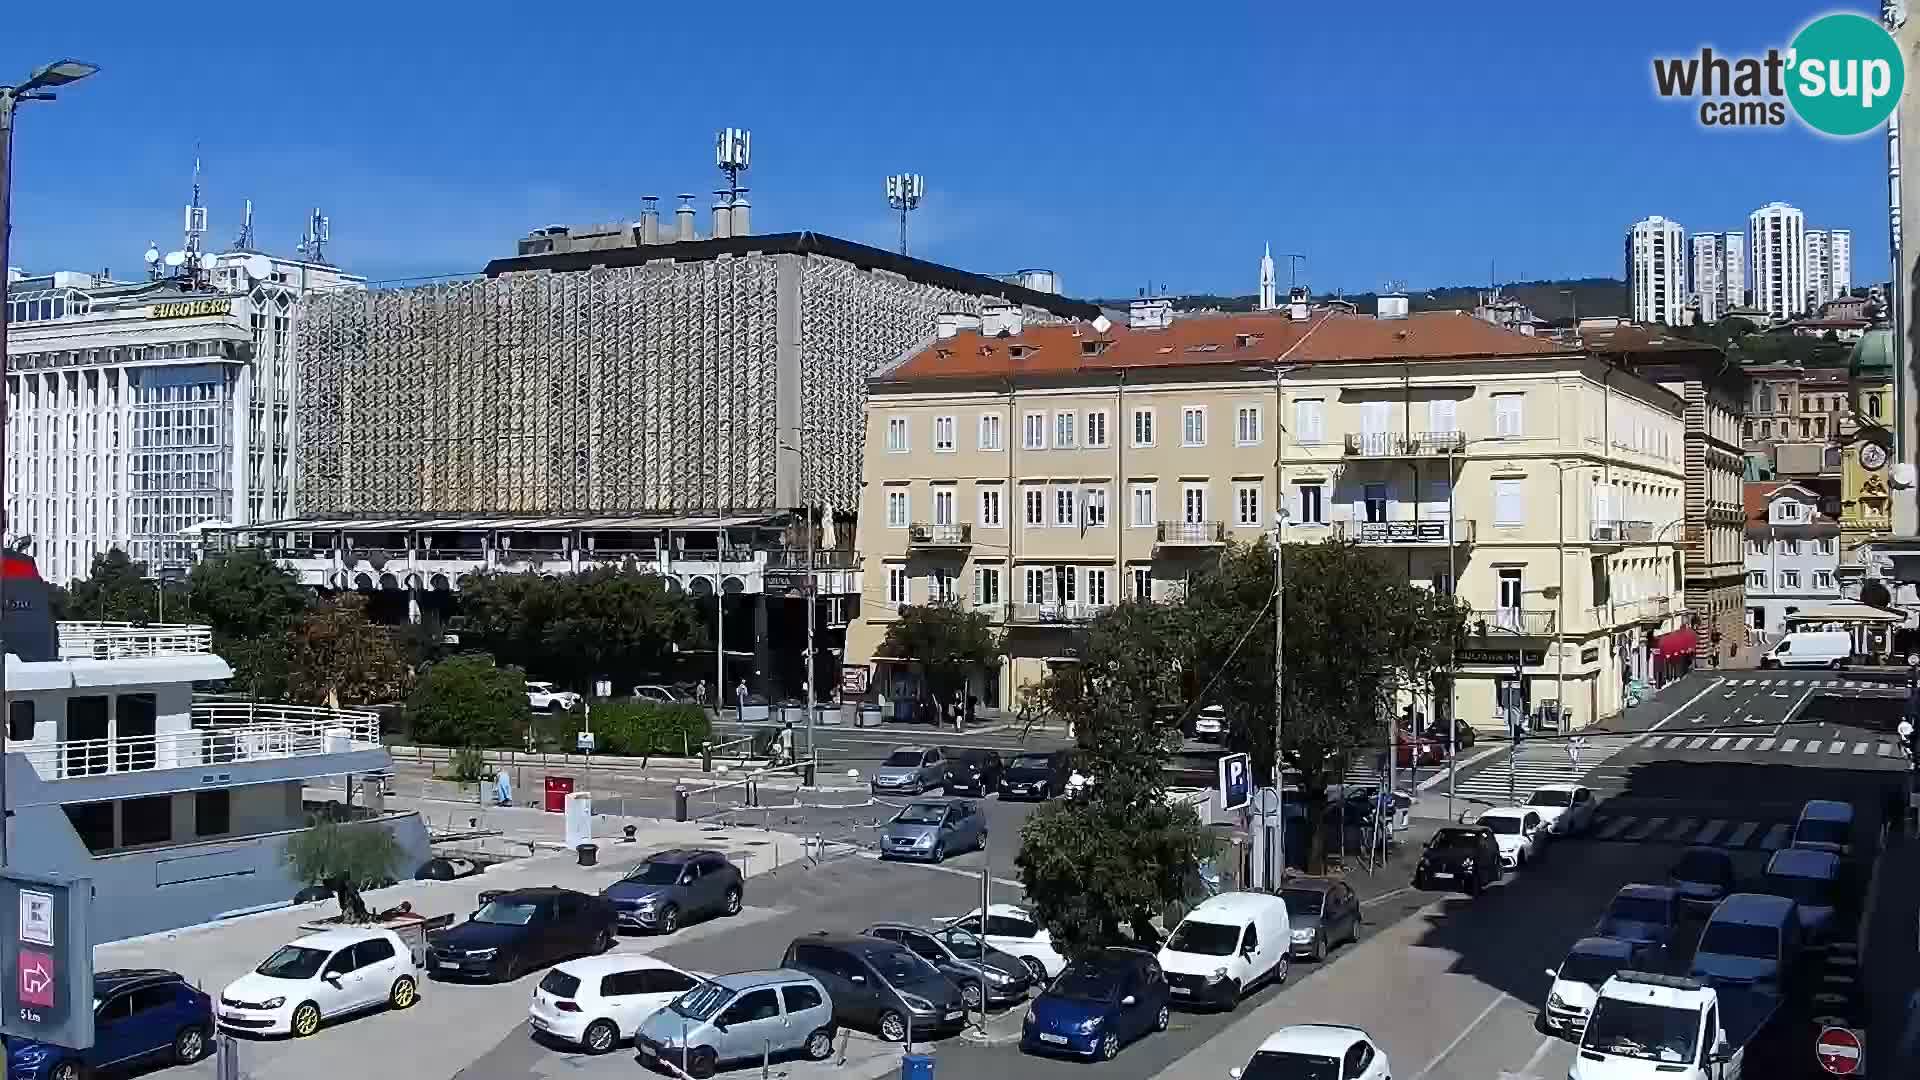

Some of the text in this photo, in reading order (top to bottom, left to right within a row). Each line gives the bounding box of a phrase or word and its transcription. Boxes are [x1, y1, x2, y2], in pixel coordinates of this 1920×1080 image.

[1230, 761, 1242, 786] P
[20, 1008, 41, 1023] 5 km
